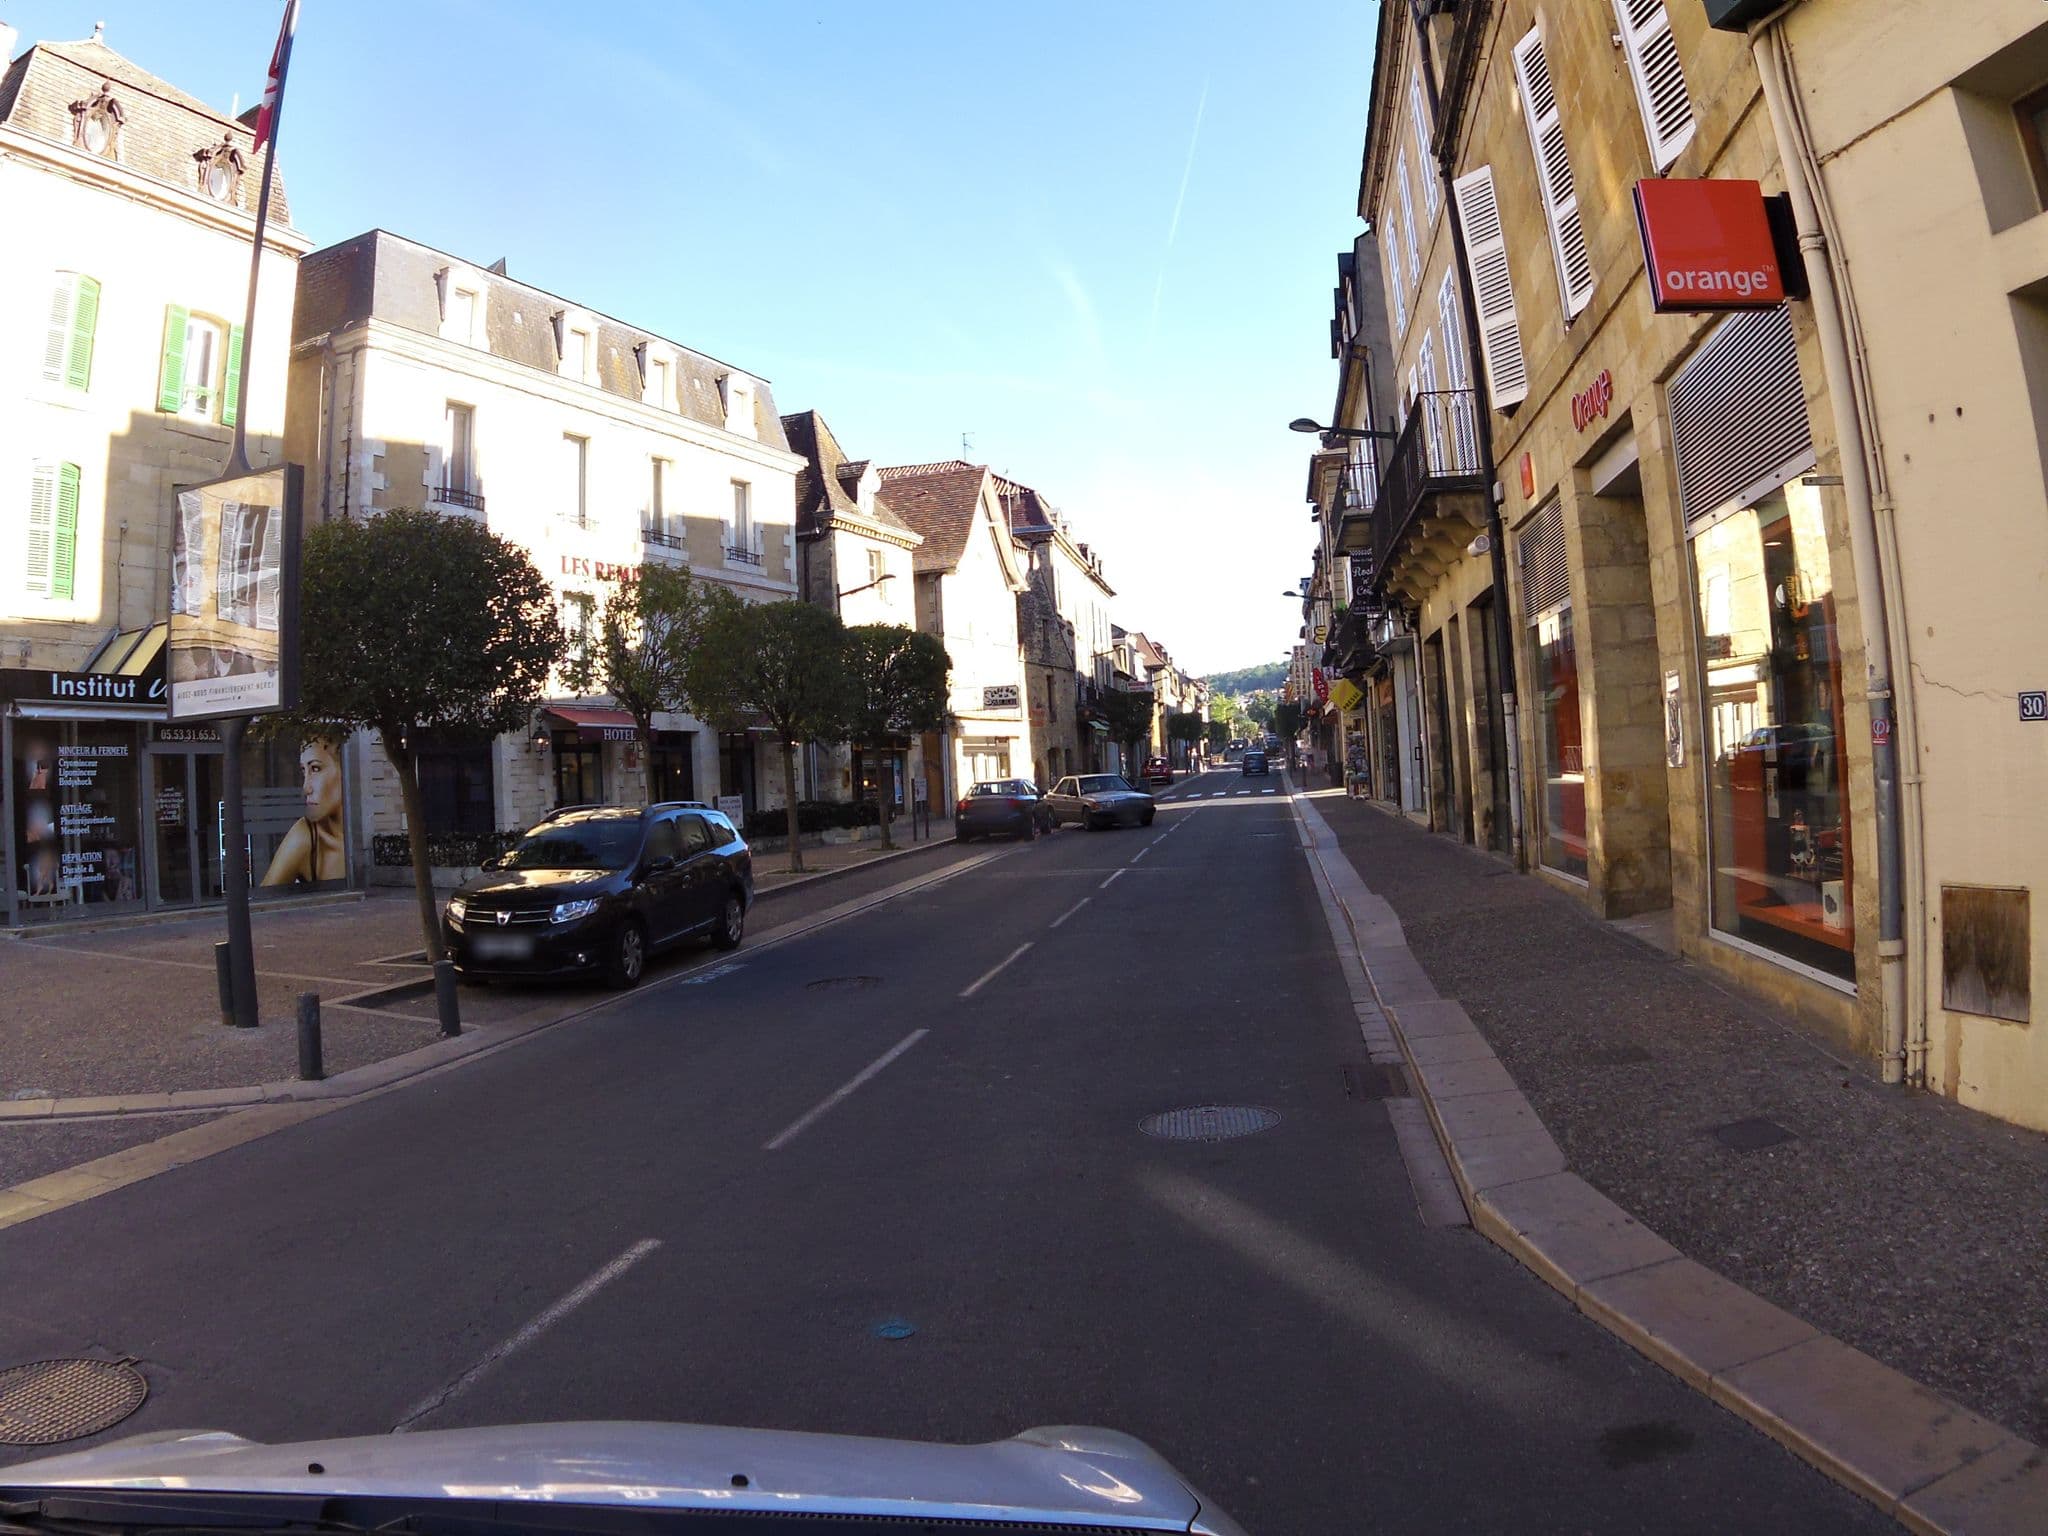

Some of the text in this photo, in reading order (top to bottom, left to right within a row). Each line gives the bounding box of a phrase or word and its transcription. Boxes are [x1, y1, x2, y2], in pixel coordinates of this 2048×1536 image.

[1666, 270, 1768, 297] orange
[561, 555, 590, 577] LES
[52, 673, 136, 698] Institut
[2023, 697, 2043, 716] 30
[603, 728, 637, 741] HOTEL
